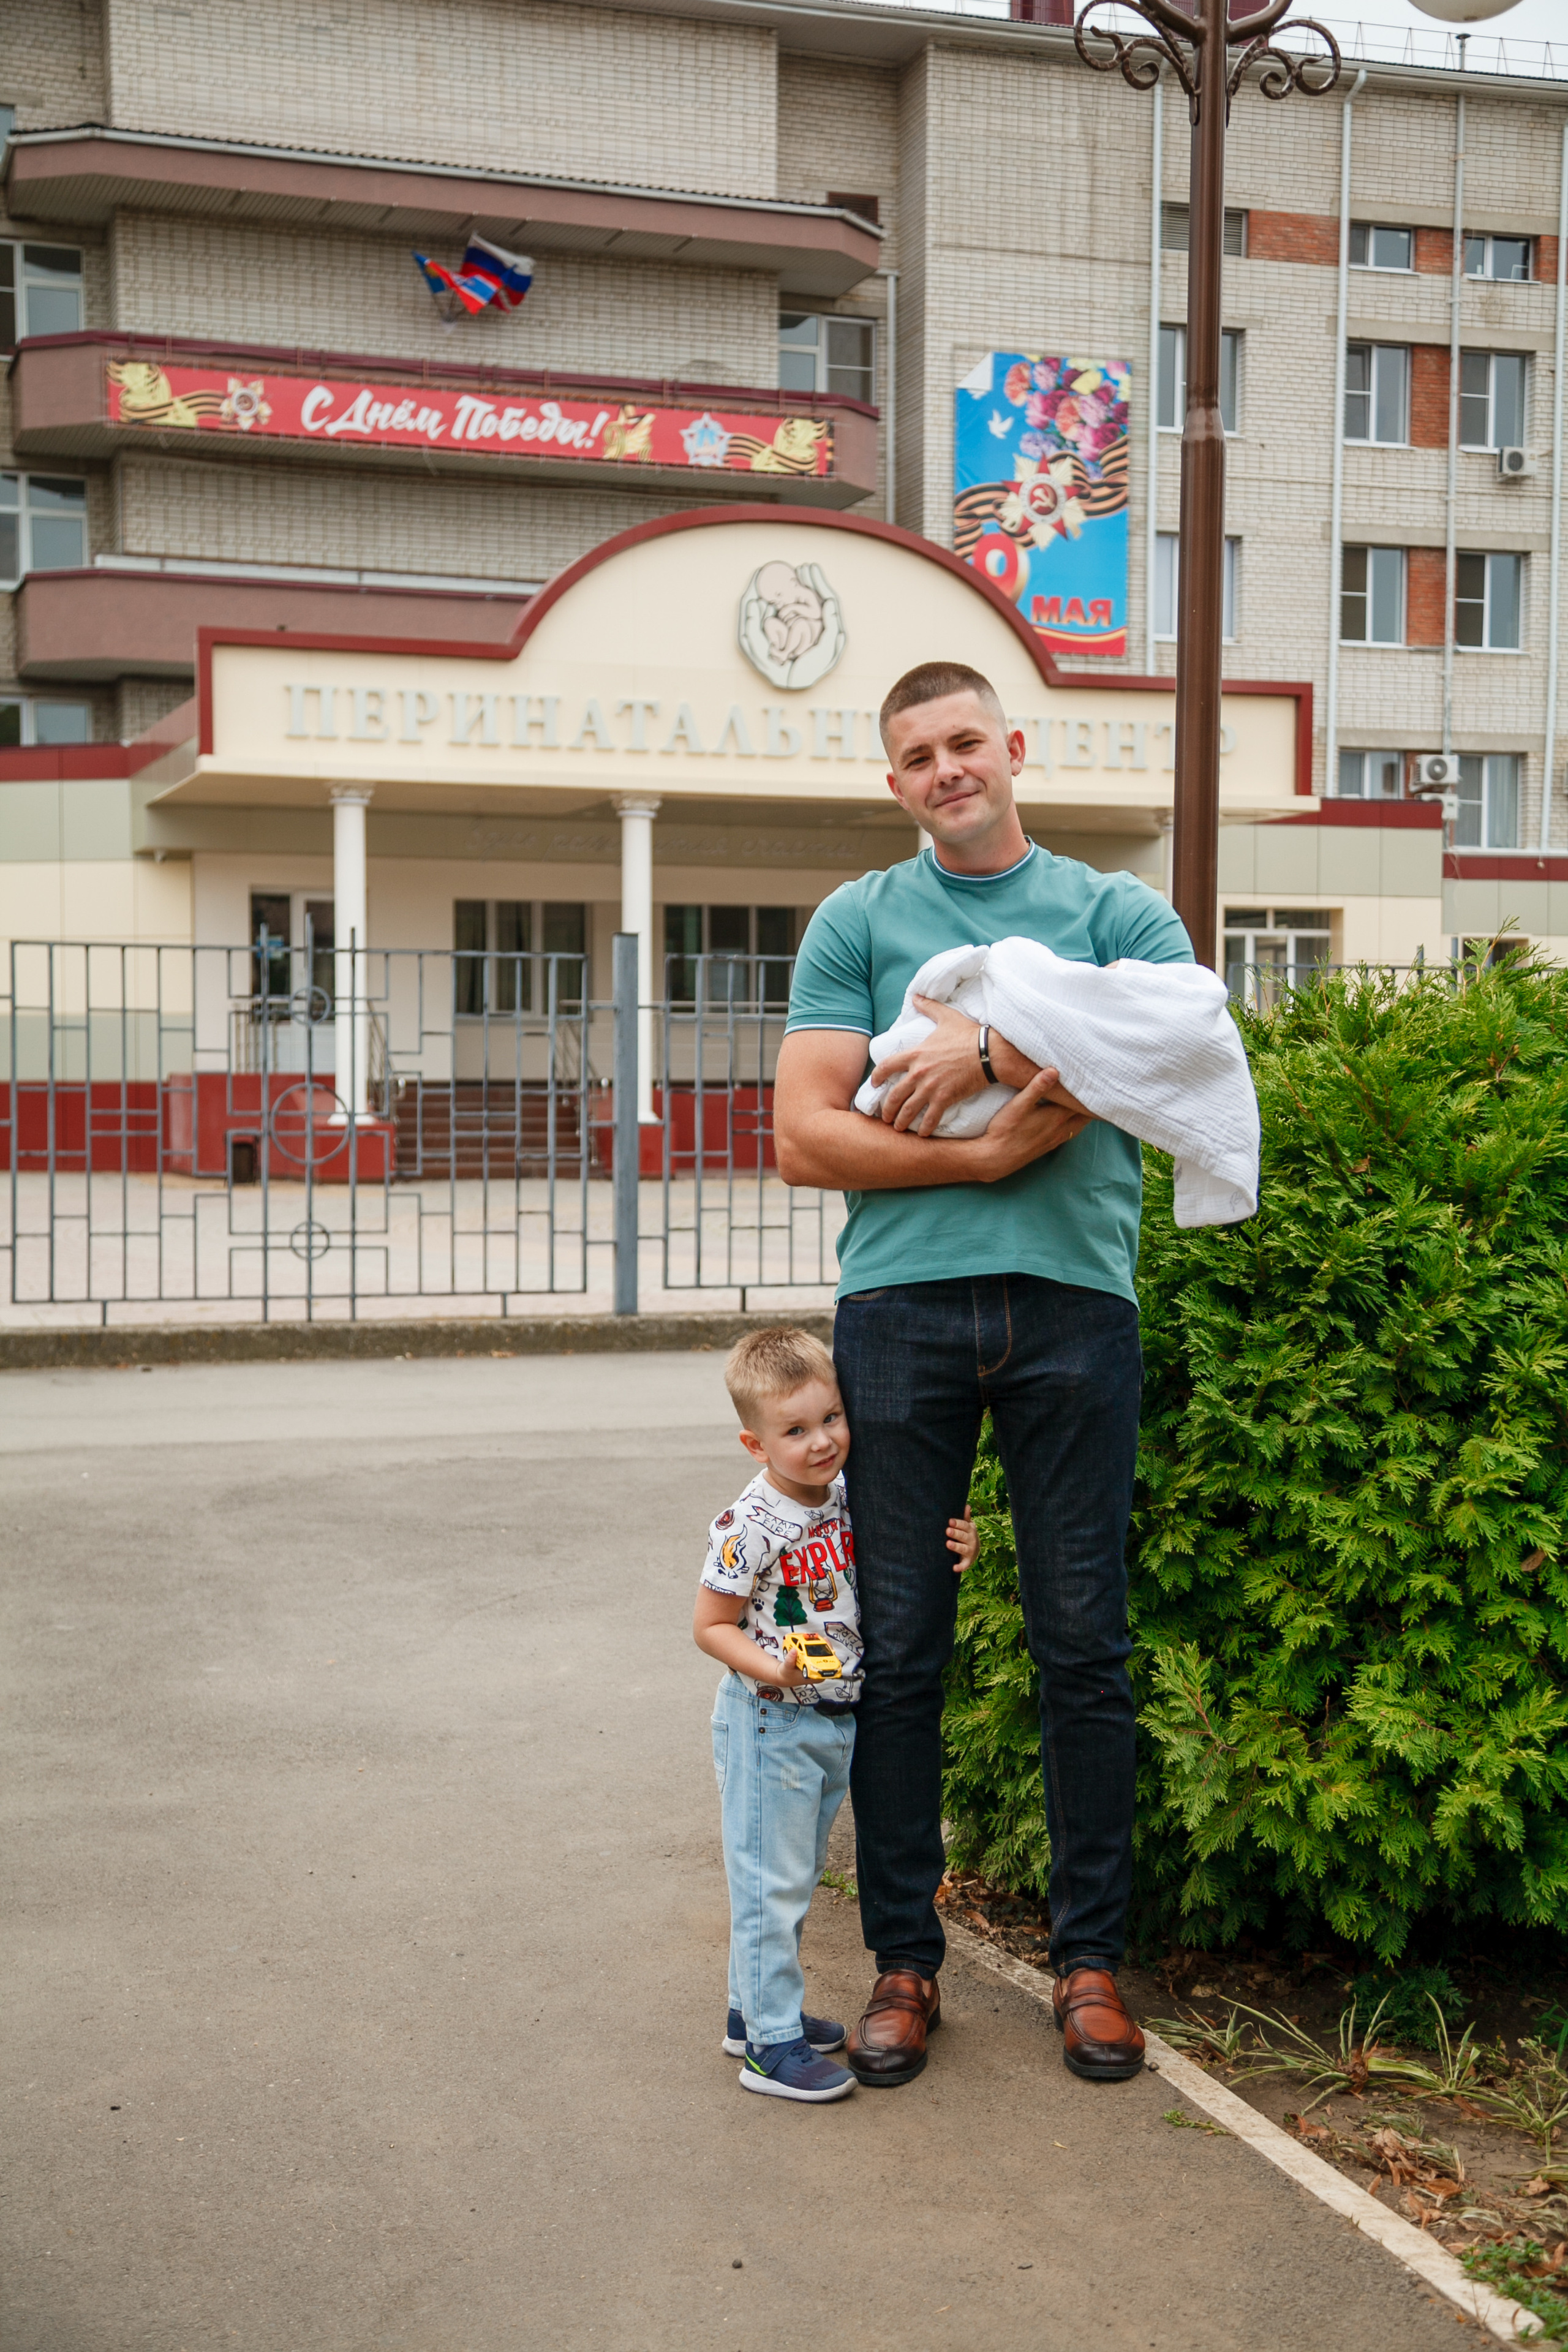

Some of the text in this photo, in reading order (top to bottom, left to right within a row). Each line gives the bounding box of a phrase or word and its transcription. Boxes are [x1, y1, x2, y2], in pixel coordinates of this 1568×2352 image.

[301, 385, 611, 450] С Днём Победы!
[1031, 595, 1113, 627] МАЯ
[763, 1519, 793, 1537] FIRE
[765, 1513, 796, 1529] CAMP
